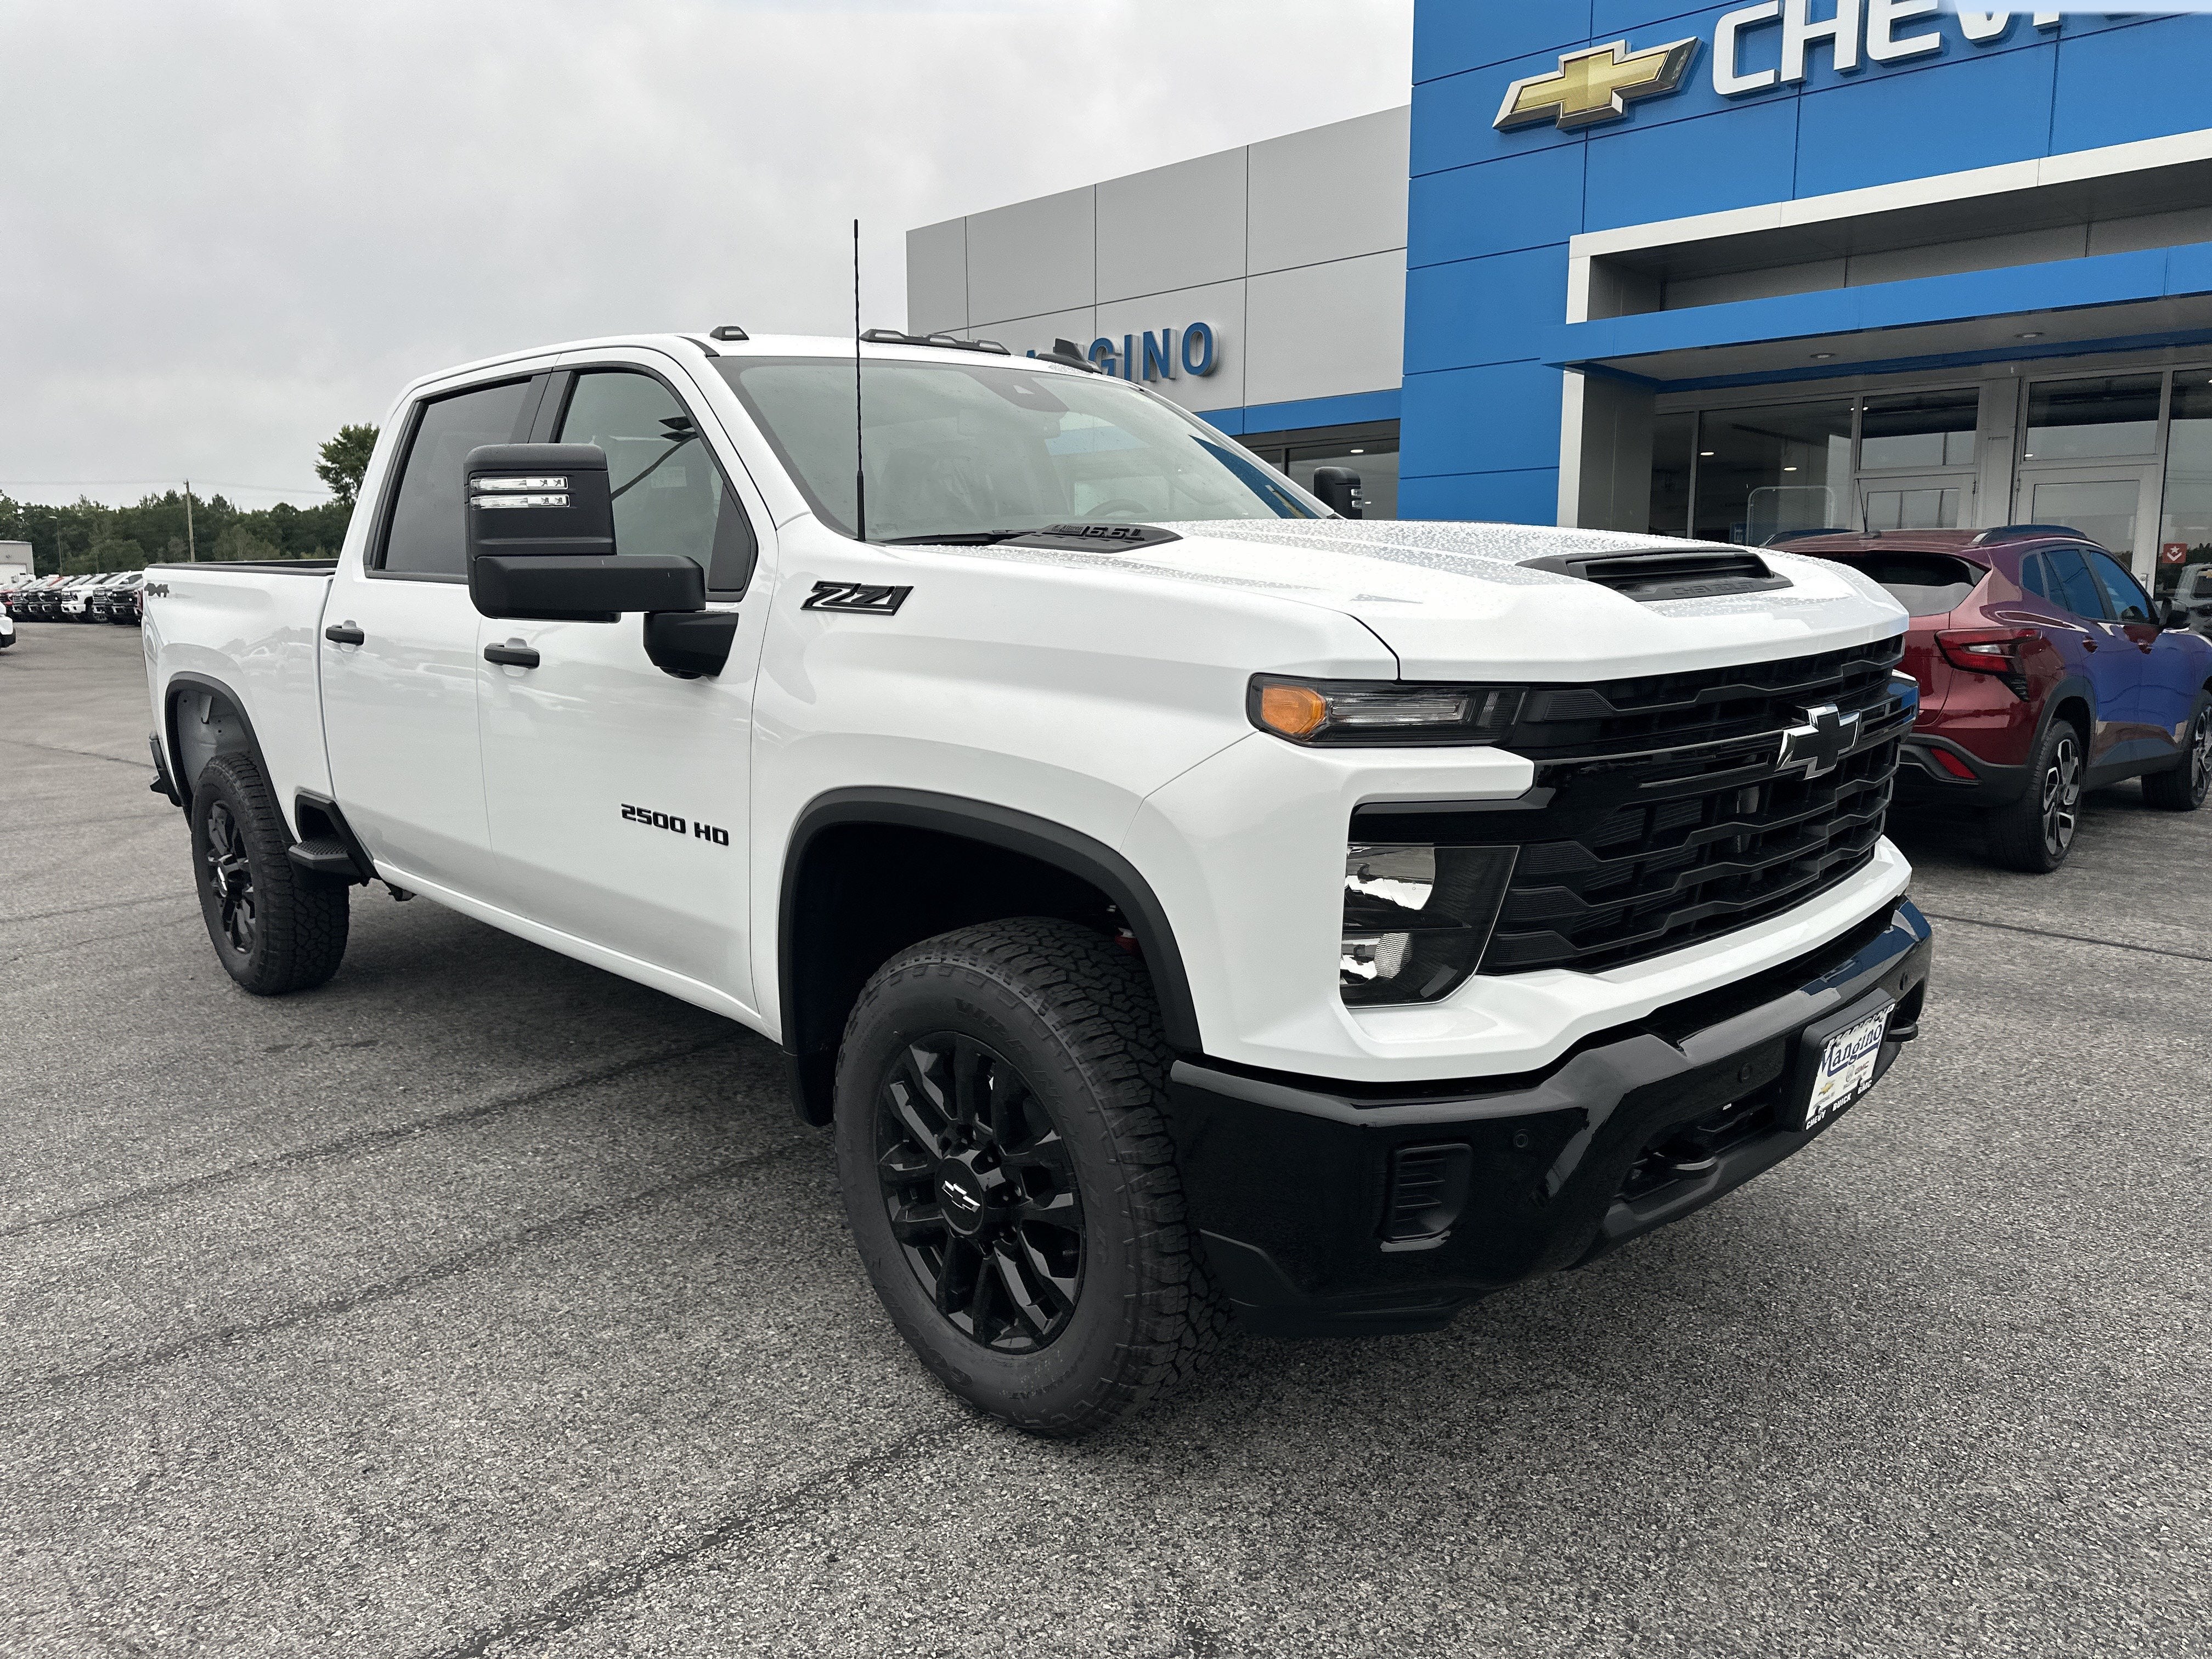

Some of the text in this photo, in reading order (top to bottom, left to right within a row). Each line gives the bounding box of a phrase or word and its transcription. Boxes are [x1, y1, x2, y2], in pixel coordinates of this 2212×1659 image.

[800, 580, 914, 616] Z71
[621, 803, 729, 846] 2500 HD
[1821, 1024, 1883, 1077] Mangino
[1805, 1110, 1826, 1130] CHEVY
[1832, 1093, 1852, 1112] BUICK
